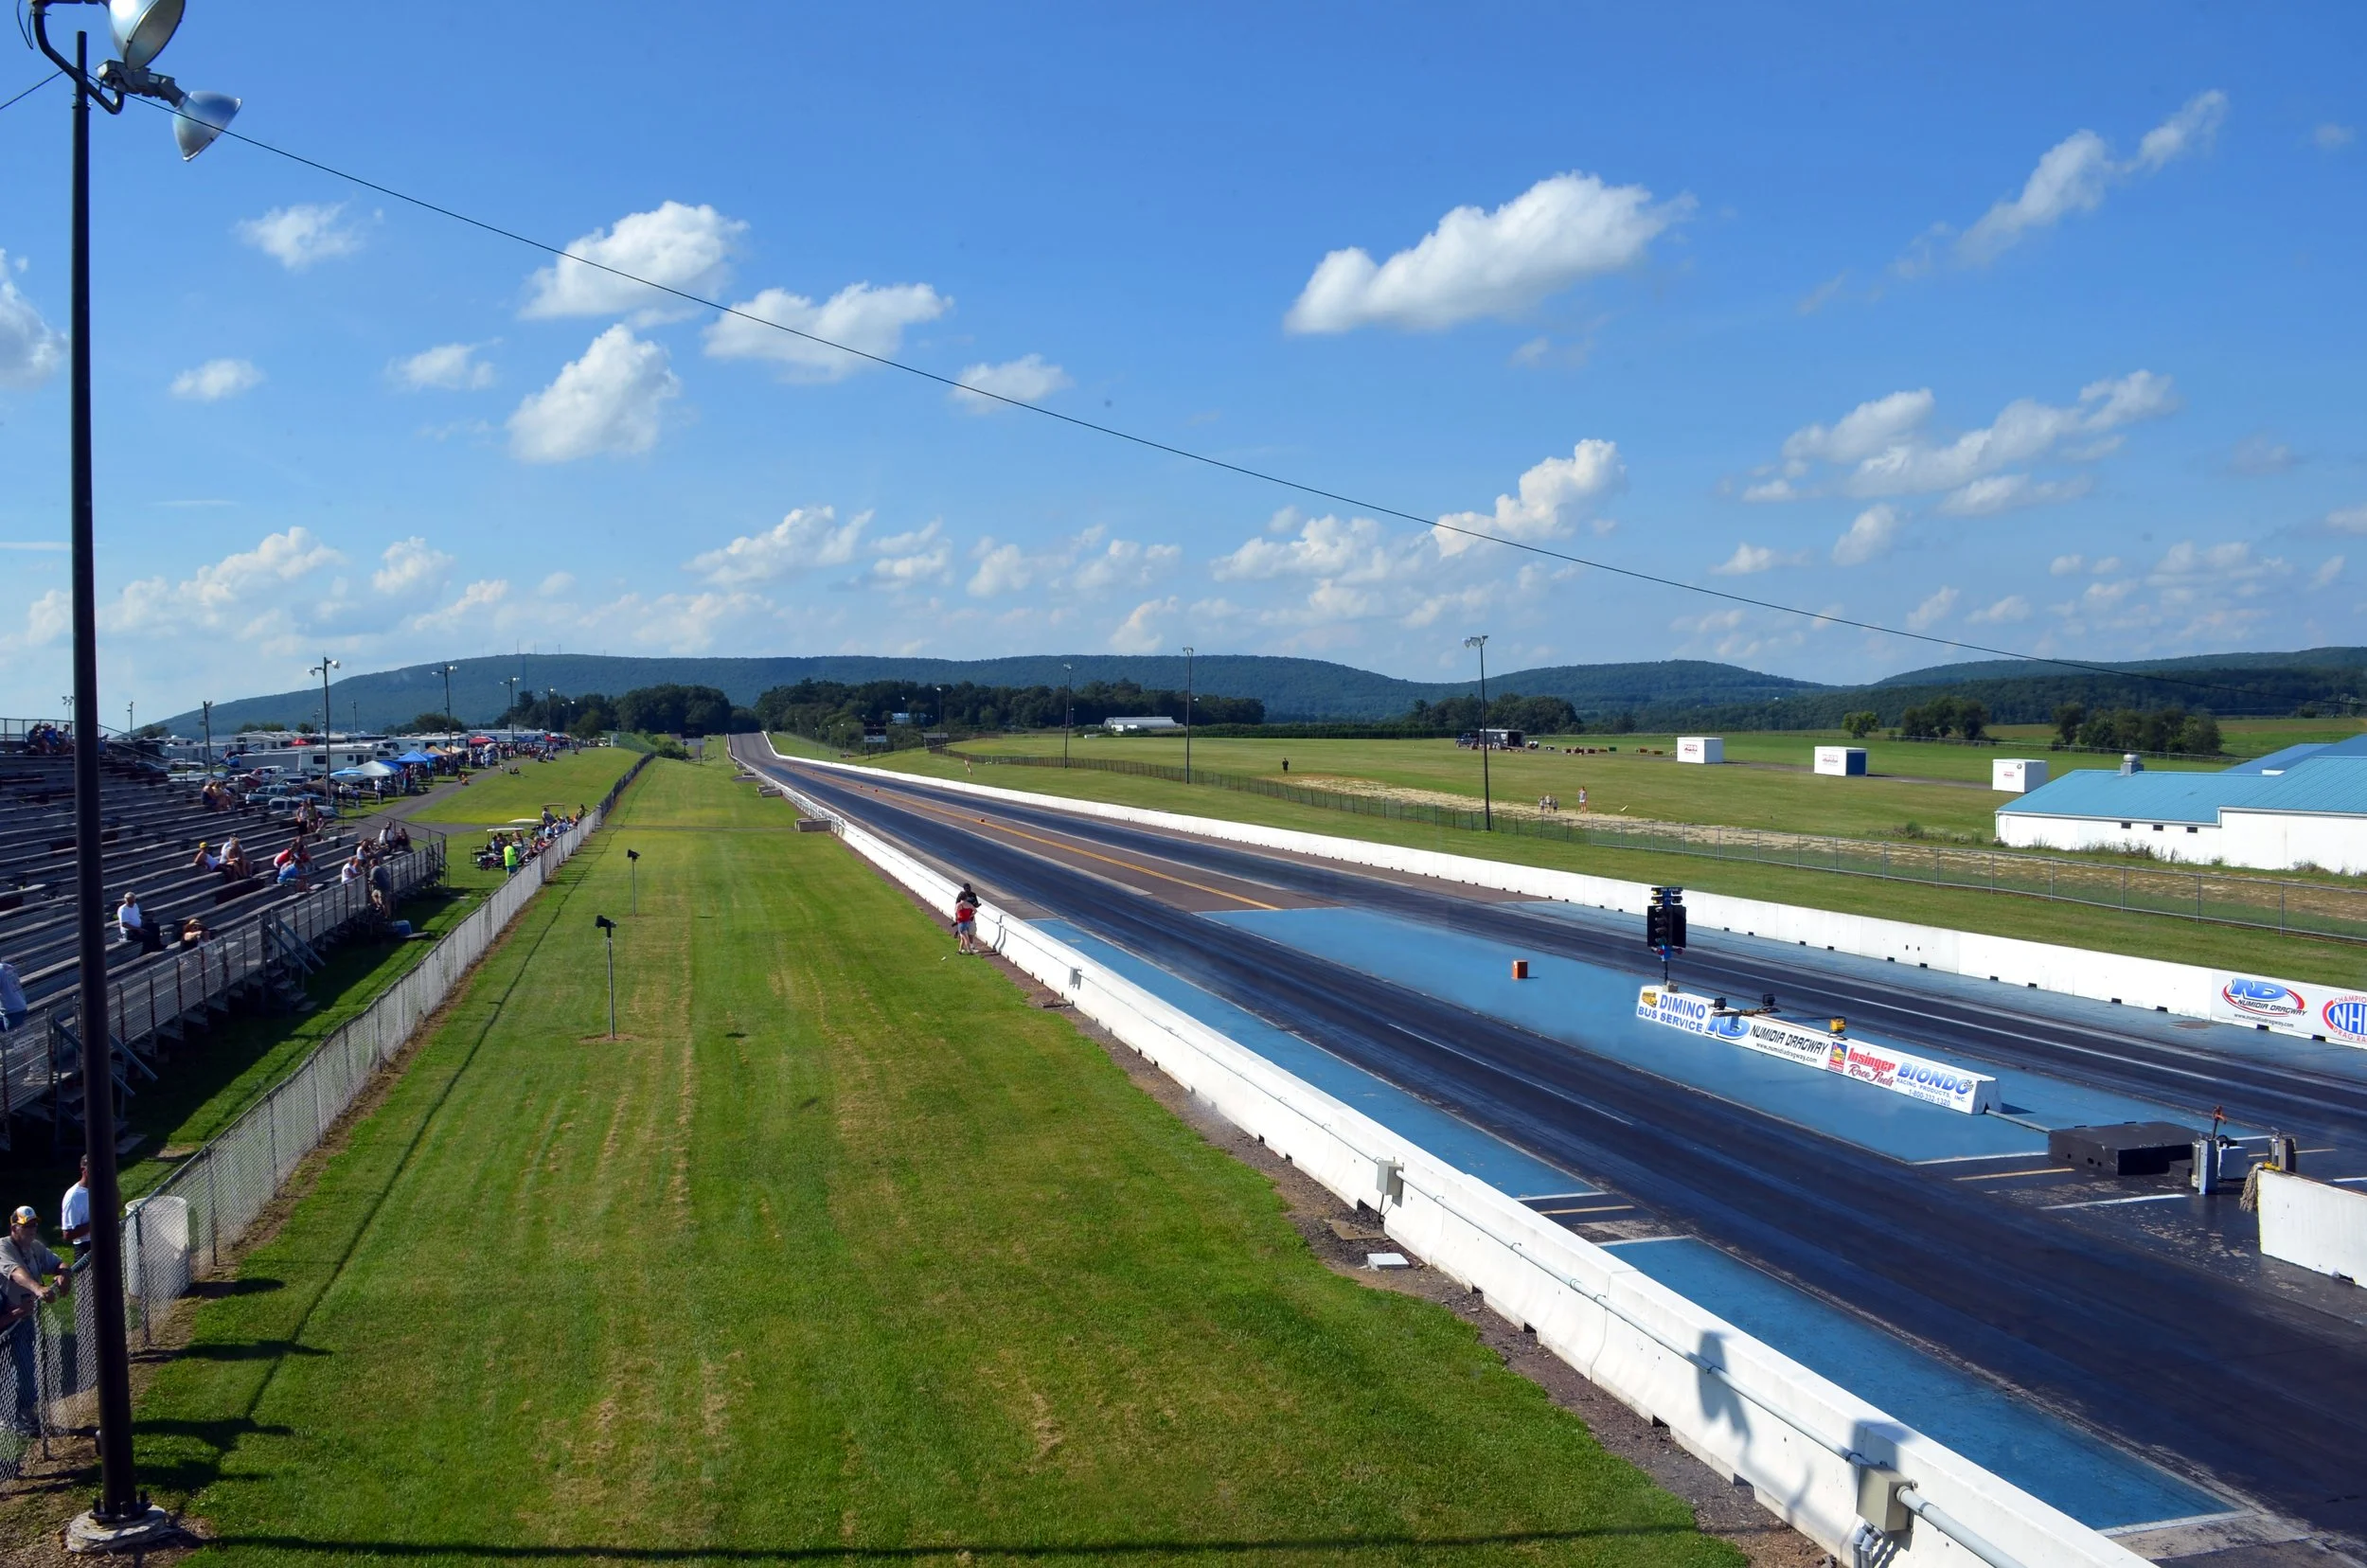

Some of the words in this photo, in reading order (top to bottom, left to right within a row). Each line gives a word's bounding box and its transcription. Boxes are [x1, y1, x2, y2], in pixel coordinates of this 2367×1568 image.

[1659, 994, 1706, 1020] DIMINO
[2237, 999, 2269, 1010] NUMIDIA
[2269, 1005, 2307, 1016] DRAGWAY
[1638, 1006, 1658, 1020] BUS
[1660, 1012, 1703, 1033] SERVICE
[2234, 1013, 2294, 1027] www.numidiadragway.com
[1750, 1025, 1784, 1043] NUMIDIA
[1785, 1034, 1829, 1056] DRAGWAY
[1756, 1042, 1818, 1063] www.numidiadragway.com
[1848, 1047, 1896, 1072] Insinger
[1848, 1064, 1871, 1080] Race
[1867, 1071, 1895, 1087] Fuels
[1896, 1078, 1916, 1088] RACING
[1897, 1061, 1971, 1095] BIONDO
[1909, 1089, 1950, 1107] 1-800-332-1320
